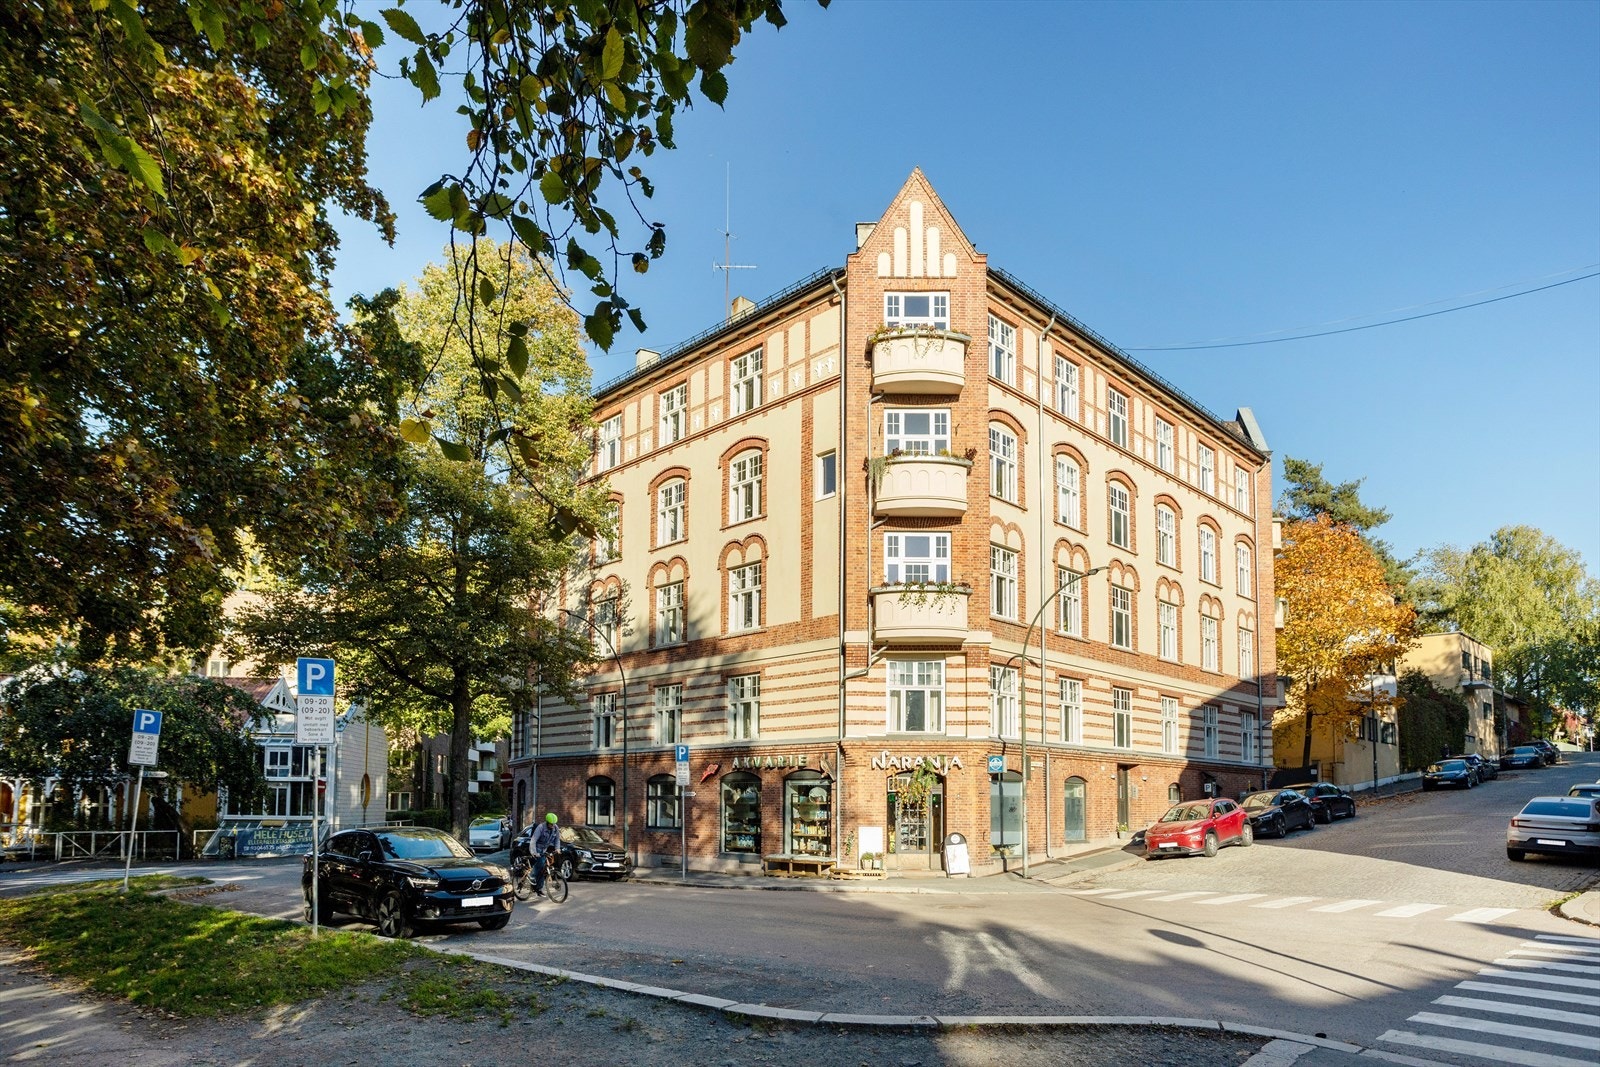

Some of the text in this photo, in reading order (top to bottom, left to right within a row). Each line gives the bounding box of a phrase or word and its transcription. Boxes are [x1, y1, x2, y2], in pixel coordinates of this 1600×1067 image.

[306, 663, 326, 690] P
[140, 713, 155, 730] P
[678, 746, 686, 760] P
[732, 755, 808, 768] AKVARIE
[871, 750, 963, 776] NARANJA
[254, 829, 310, 839] HELE HUSET
